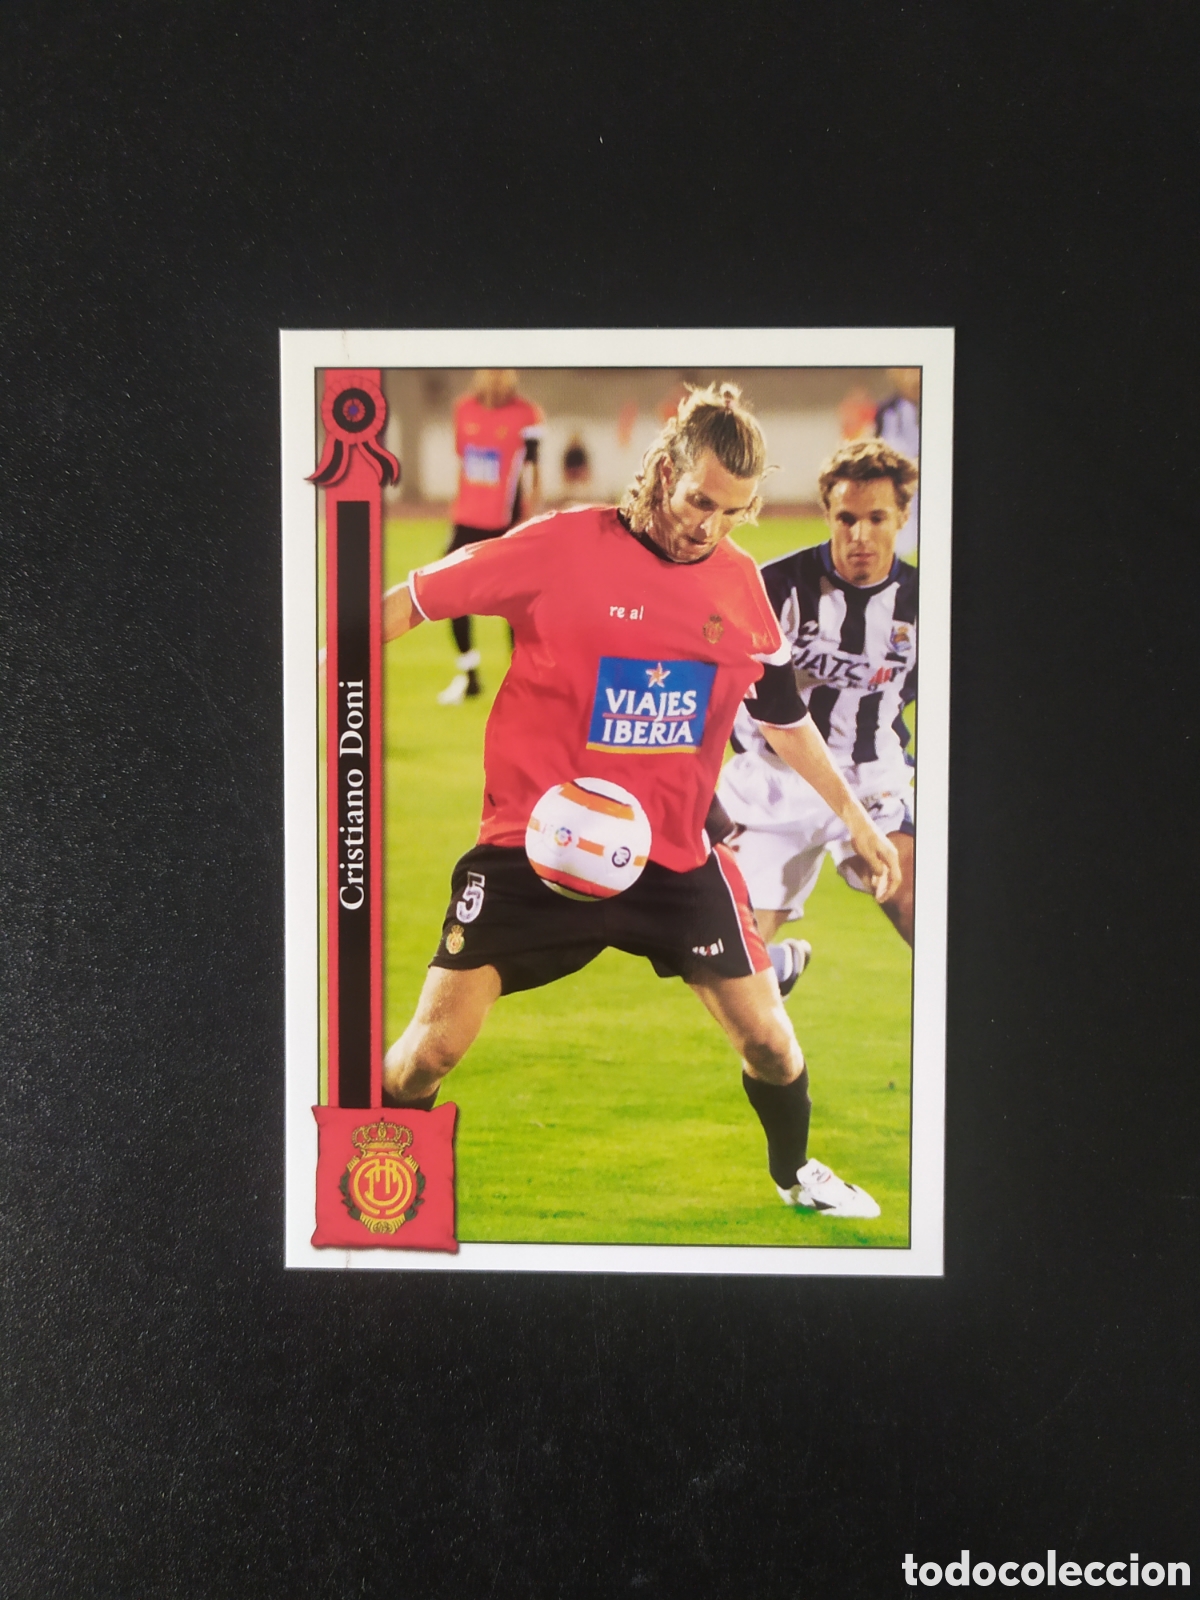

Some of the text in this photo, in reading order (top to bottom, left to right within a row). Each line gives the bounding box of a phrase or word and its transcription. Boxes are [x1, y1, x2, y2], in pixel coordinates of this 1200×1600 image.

[605, 688, 697, 722] VIAJES
[602, 719, 694, 744] IBERIA
[339, 680, 365, 911] Cristiano Doni
[456, 871, 485, 923] 5
